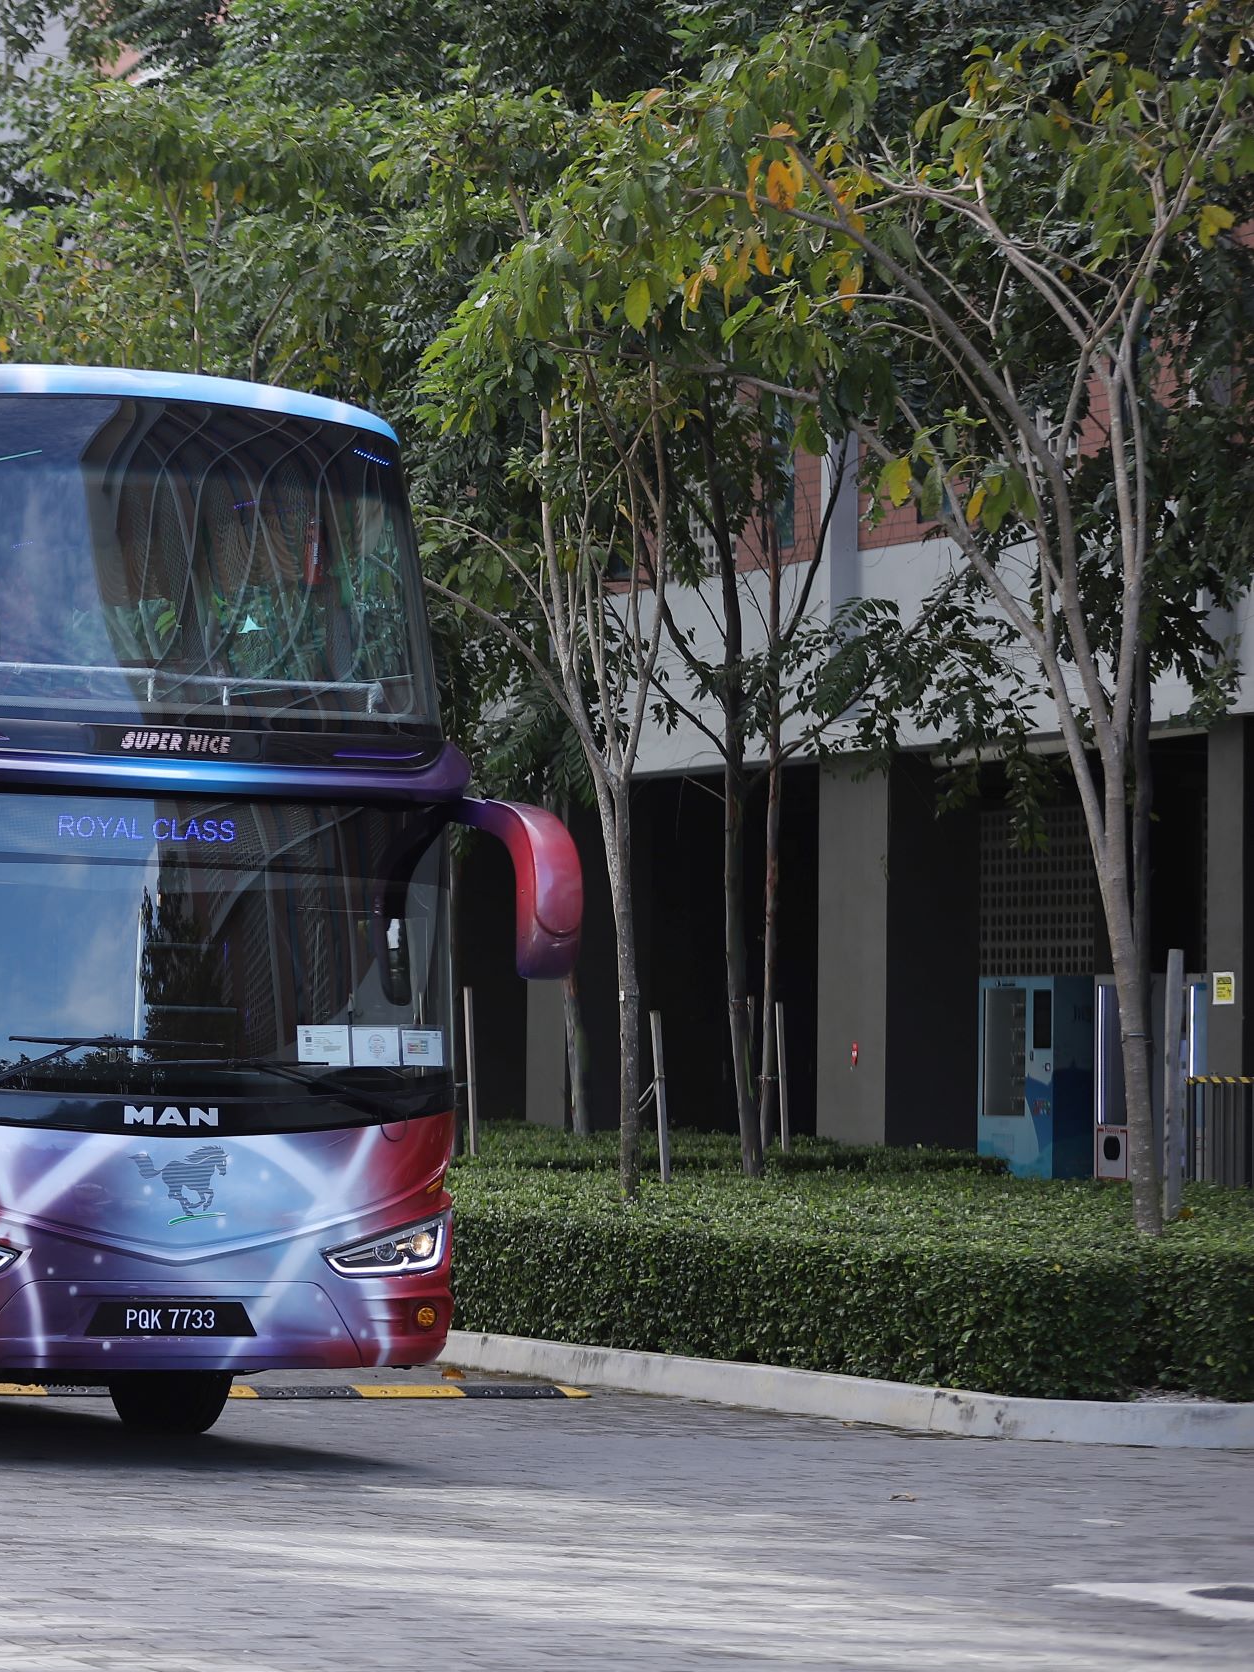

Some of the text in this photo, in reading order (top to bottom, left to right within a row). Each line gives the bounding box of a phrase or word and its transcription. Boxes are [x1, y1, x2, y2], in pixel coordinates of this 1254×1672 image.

[121, 731, 231, 754] SUPER NICE
[57, 815, 235, 843] ROYAL CLASS
[124, 1105, 219, 1127] MAN
[126, 1309, 215, 1330] PQK 7733
